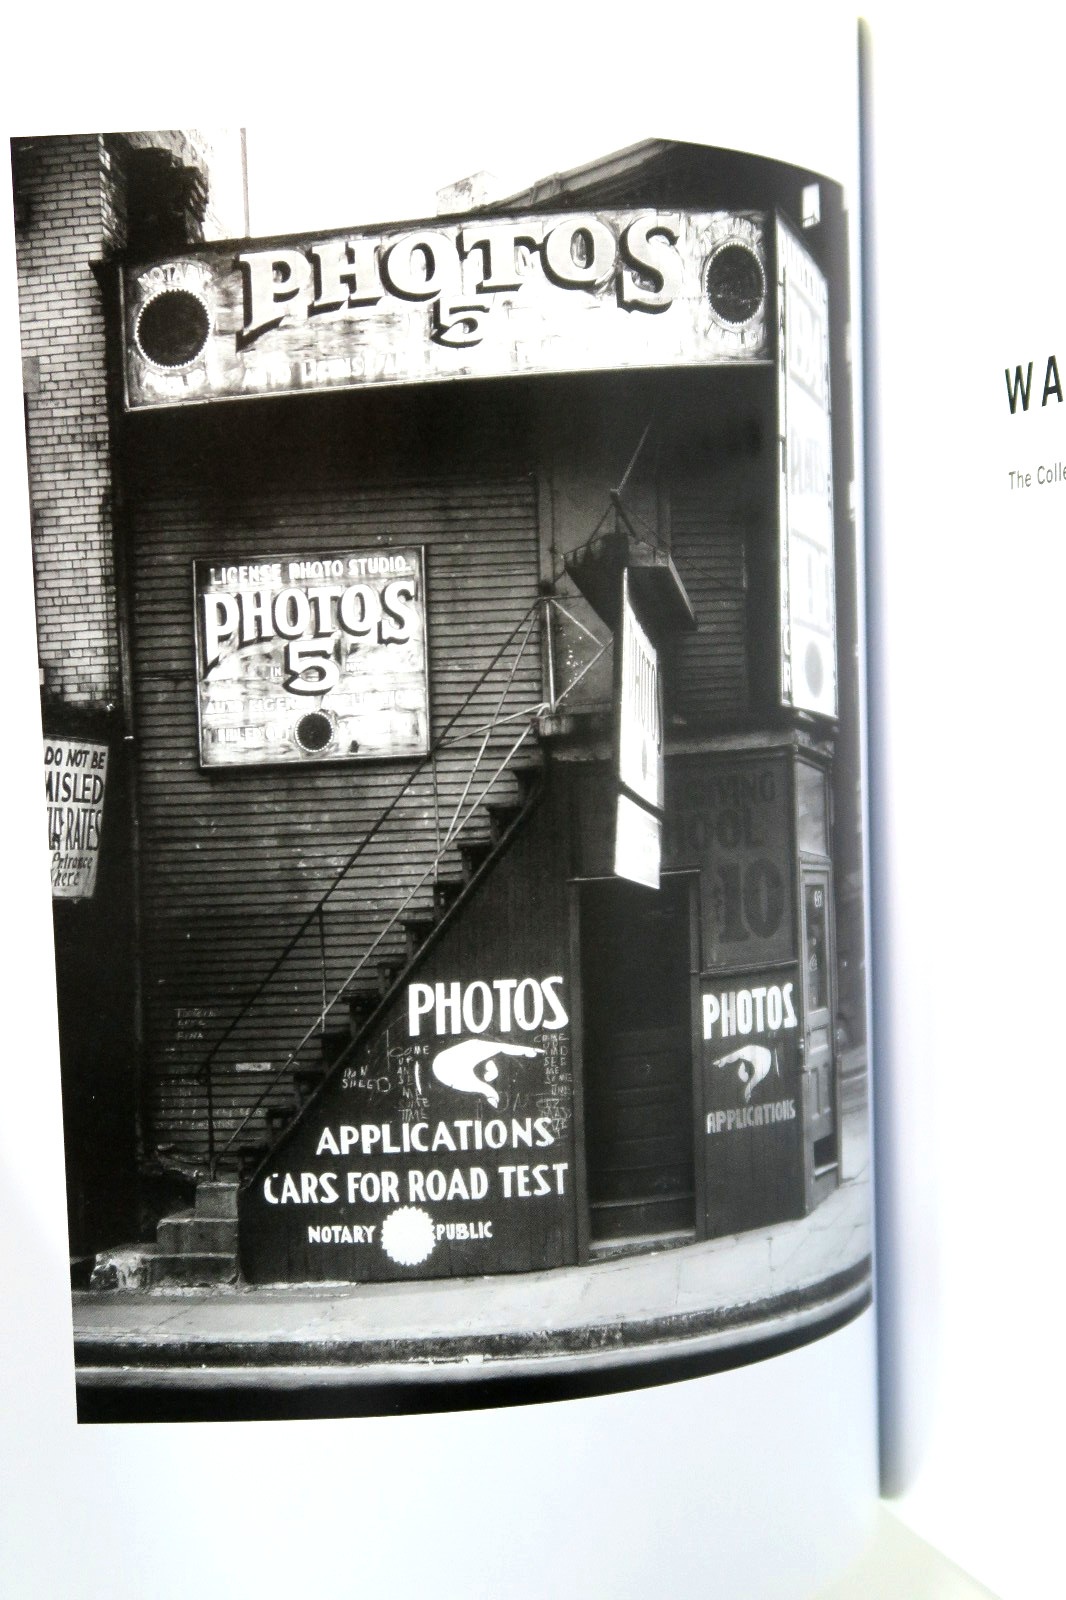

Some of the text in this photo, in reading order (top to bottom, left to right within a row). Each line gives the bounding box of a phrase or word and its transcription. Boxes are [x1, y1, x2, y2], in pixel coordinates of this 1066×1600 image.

[235, 213, 683, 351] PHOTOS
[429, 304, 490, 348] 5
[1008, 471, 1032, 490] The
[210, 564, 282, 586] LICENSE
[288, 560, 344, 580] PHOTO
[202, 579, 421, 680] PHOTOS
[282, 638, 340, 697] 5
[44, 745, 106, 770] DO NOT BE
[408, 975, 570, 1037] PHOTOS
[702, 982, 798, 1040] PHOTOS
[315, 1117, 555, 1156] APPLICATIONS
[706, 1100, 797, 1135] APPLICATIONS
[263, 1162, 569, 1205] CARS FOR ROAD TEST
[307, 1220, 493, 1244] NOTARY PUBLIC
